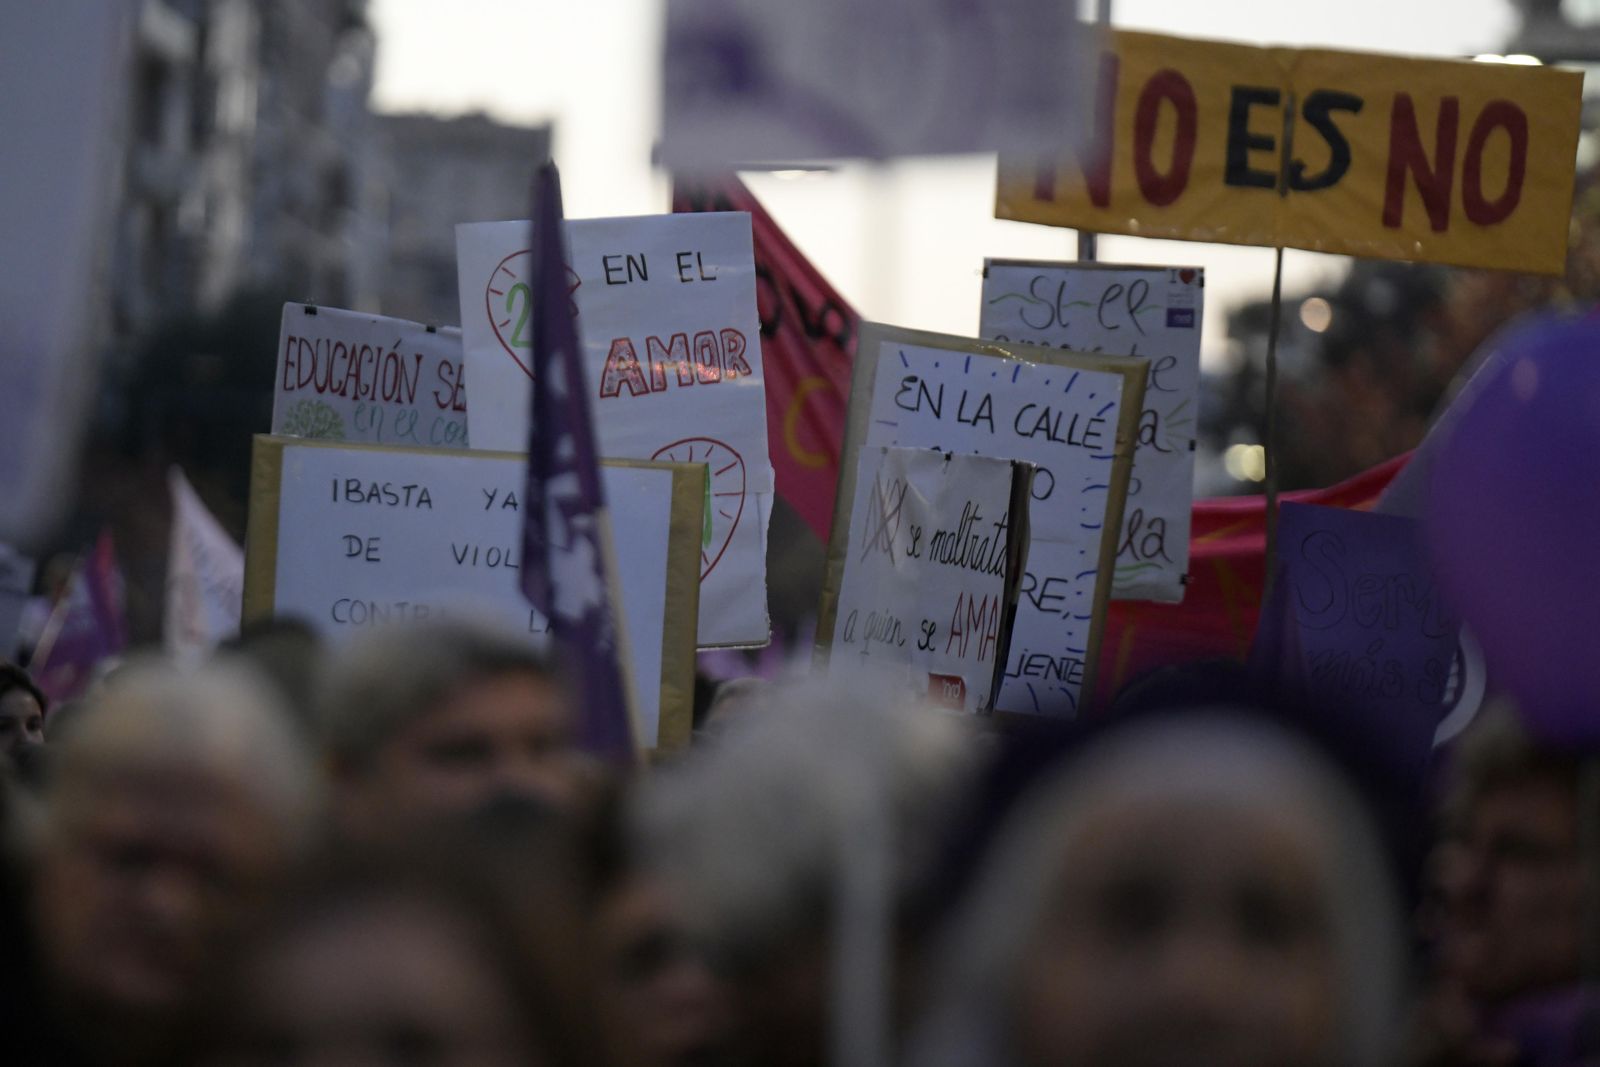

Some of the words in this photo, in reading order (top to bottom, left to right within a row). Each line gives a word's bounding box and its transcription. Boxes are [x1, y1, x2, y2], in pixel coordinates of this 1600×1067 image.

[1224, 84, 1364, 197] ES
[1382, 91, 1529, 233] NO
[603, 253, 649, 285] EN
[676, 251, 717, 283] EL
[283, 335, 424, 405] EDUCACIÓN
[600, 328, 752, 398] AMOR
[895, 375, 943, 419] EN
[957, 390, 995, 434] LA
[482, 487, 519, 511] YA
[342, 534, 381, 562] DE
[917, 618, 937, 652] se
[945, 591, 999, 661] AMA
